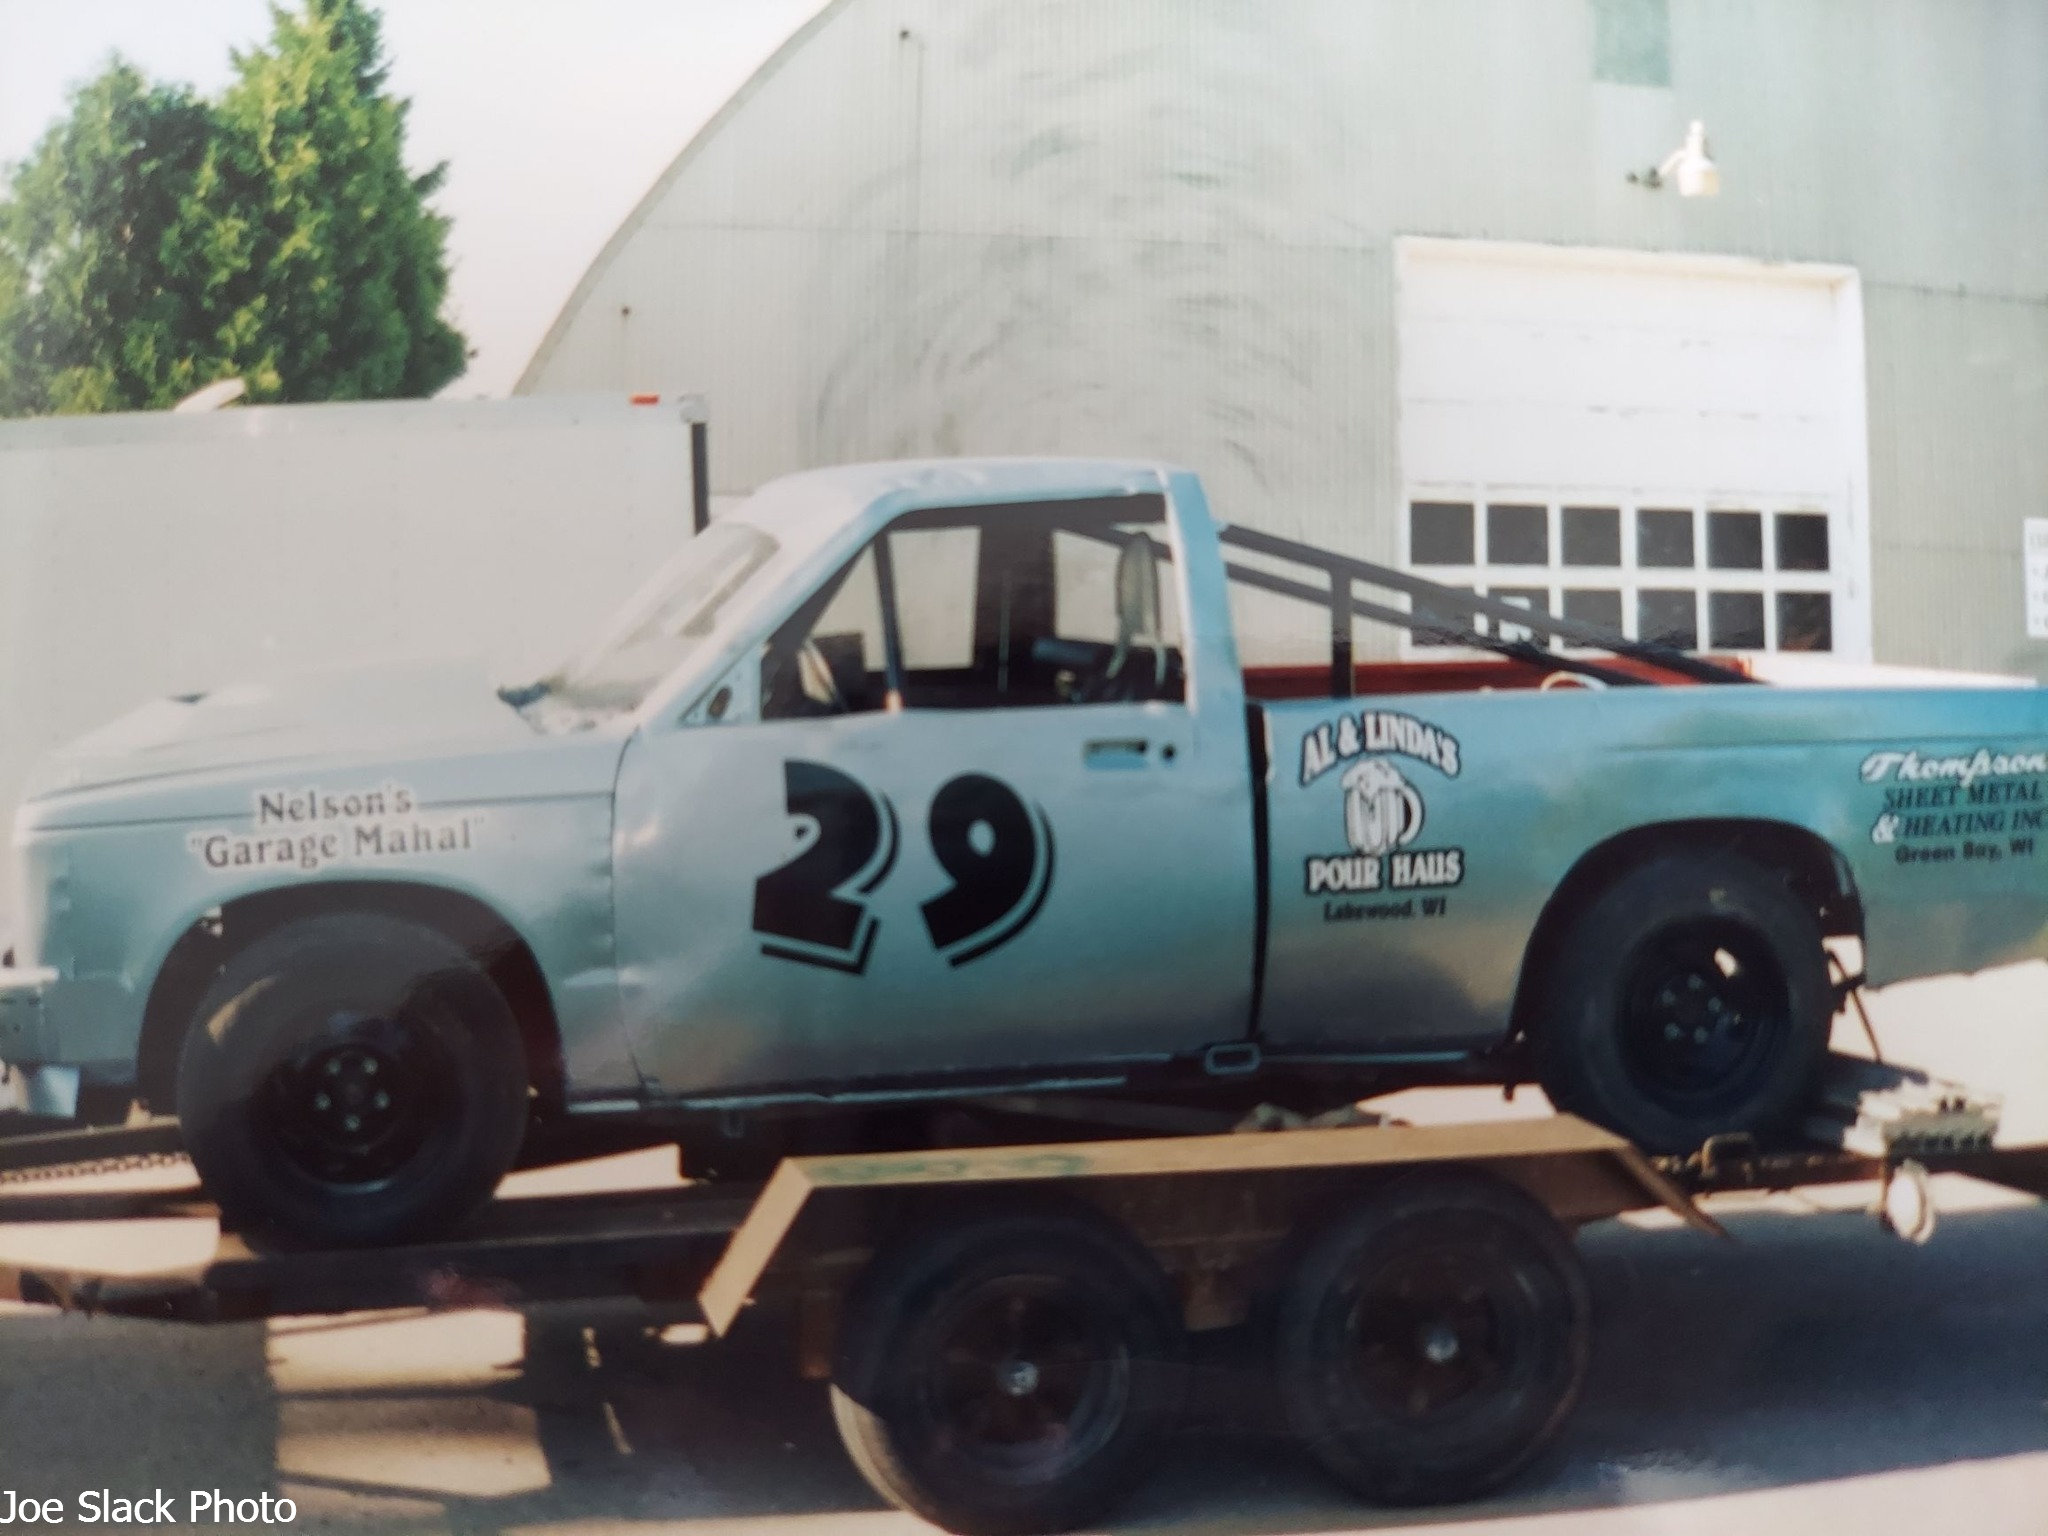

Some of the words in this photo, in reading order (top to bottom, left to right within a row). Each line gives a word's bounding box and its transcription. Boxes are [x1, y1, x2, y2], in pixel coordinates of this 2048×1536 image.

[1301, 721, 1337, 786] AL
[1338, 714, 1361, 759] &
[1362, 709, 1461, 779] LINDA'S
[1860, 749, 2047, 788] Thompson
[259, 785, 411, 823] Nelson's
[1884, 785, 1957, 810] SHEET
[1969, 780, 2042, 804] METAL
[1871, 812, 1901, 845] &
[1904, 811, 2005, 837] HEATING
[752, 758, 1055, 976] 29
[1305, 854, 1383, 894] POUR
